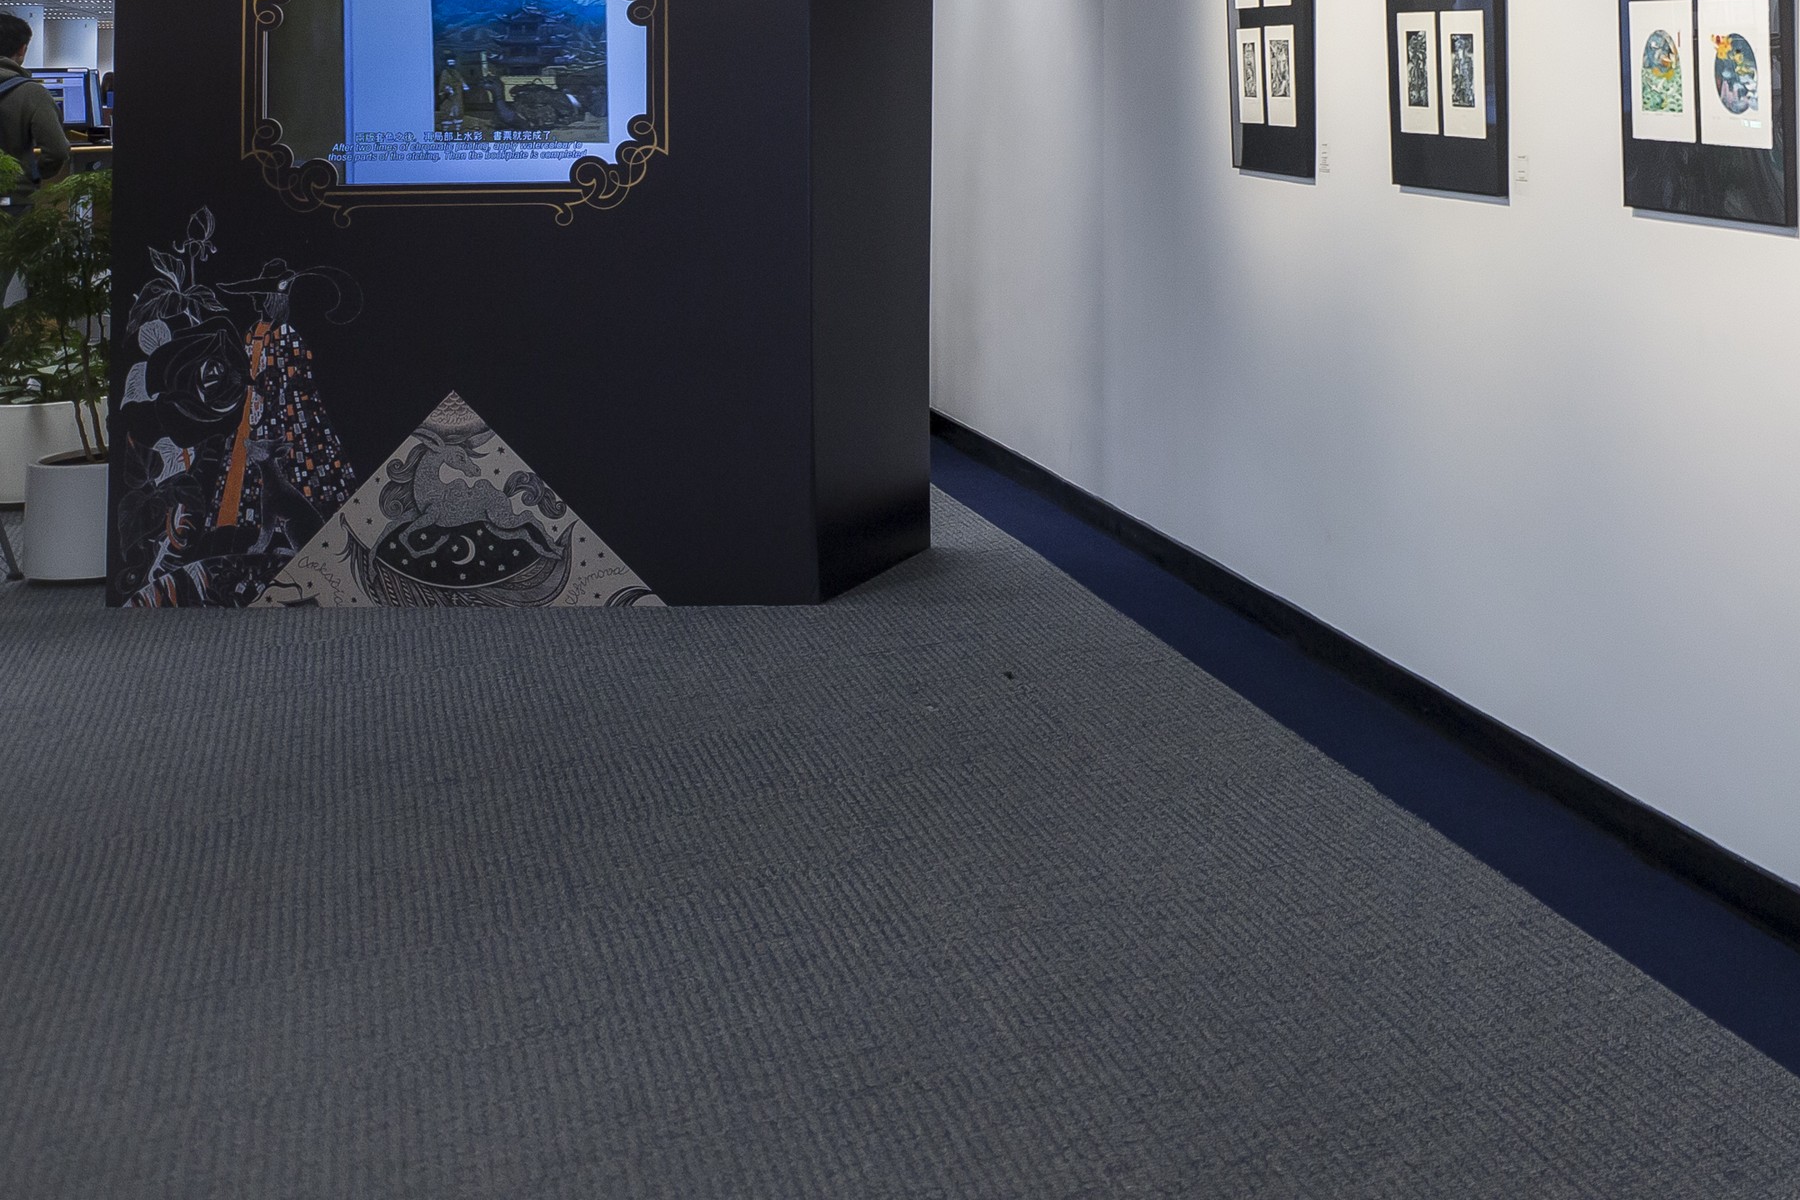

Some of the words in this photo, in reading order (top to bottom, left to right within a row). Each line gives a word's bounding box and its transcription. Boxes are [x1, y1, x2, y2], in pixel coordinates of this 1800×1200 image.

[332, 143, 354, 152] After
[355, 143, 373, 152] two
[373, 143, 398, 152] times
[399, 142, 410, 151] of
[493, 142, 518, 152] apply
[519, 141, 572, 150] watercolour
[573, 141, 583, 149] to
[328, 153, 352, 161] those
[354, 153, 377, 162] parts
[379, 153, 389, 161] of
[390, 152, 404, 161] the
[445, 151, 467, 160] Then
[468, 151, 483, 160] the
[484, 150, 529, 160] bookplate
[530, 150, 538, 159] is
